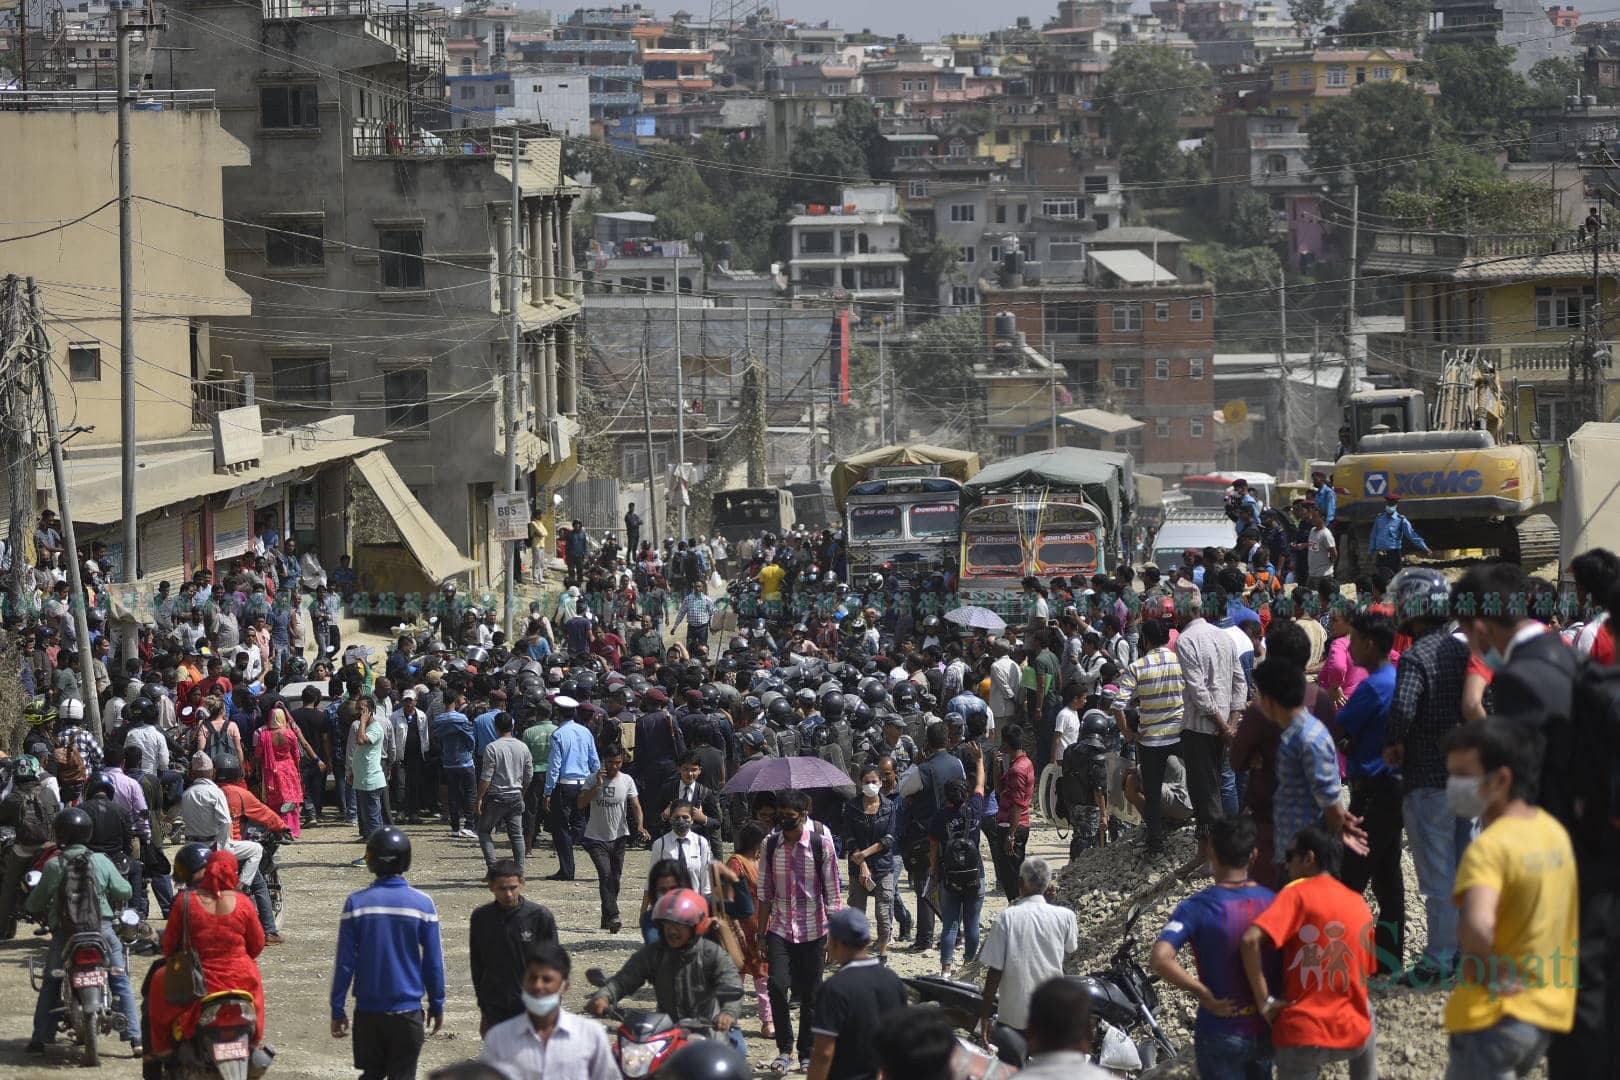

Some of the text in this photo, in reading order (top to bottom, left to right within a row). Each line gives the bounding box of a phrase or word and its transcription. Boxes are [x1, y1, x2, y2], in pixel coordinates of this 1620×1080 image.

[1395, 469, 1483, 496] XCMG
[497, 506, 517, 516] BBS
[596, 799, 620, 808] Viber
